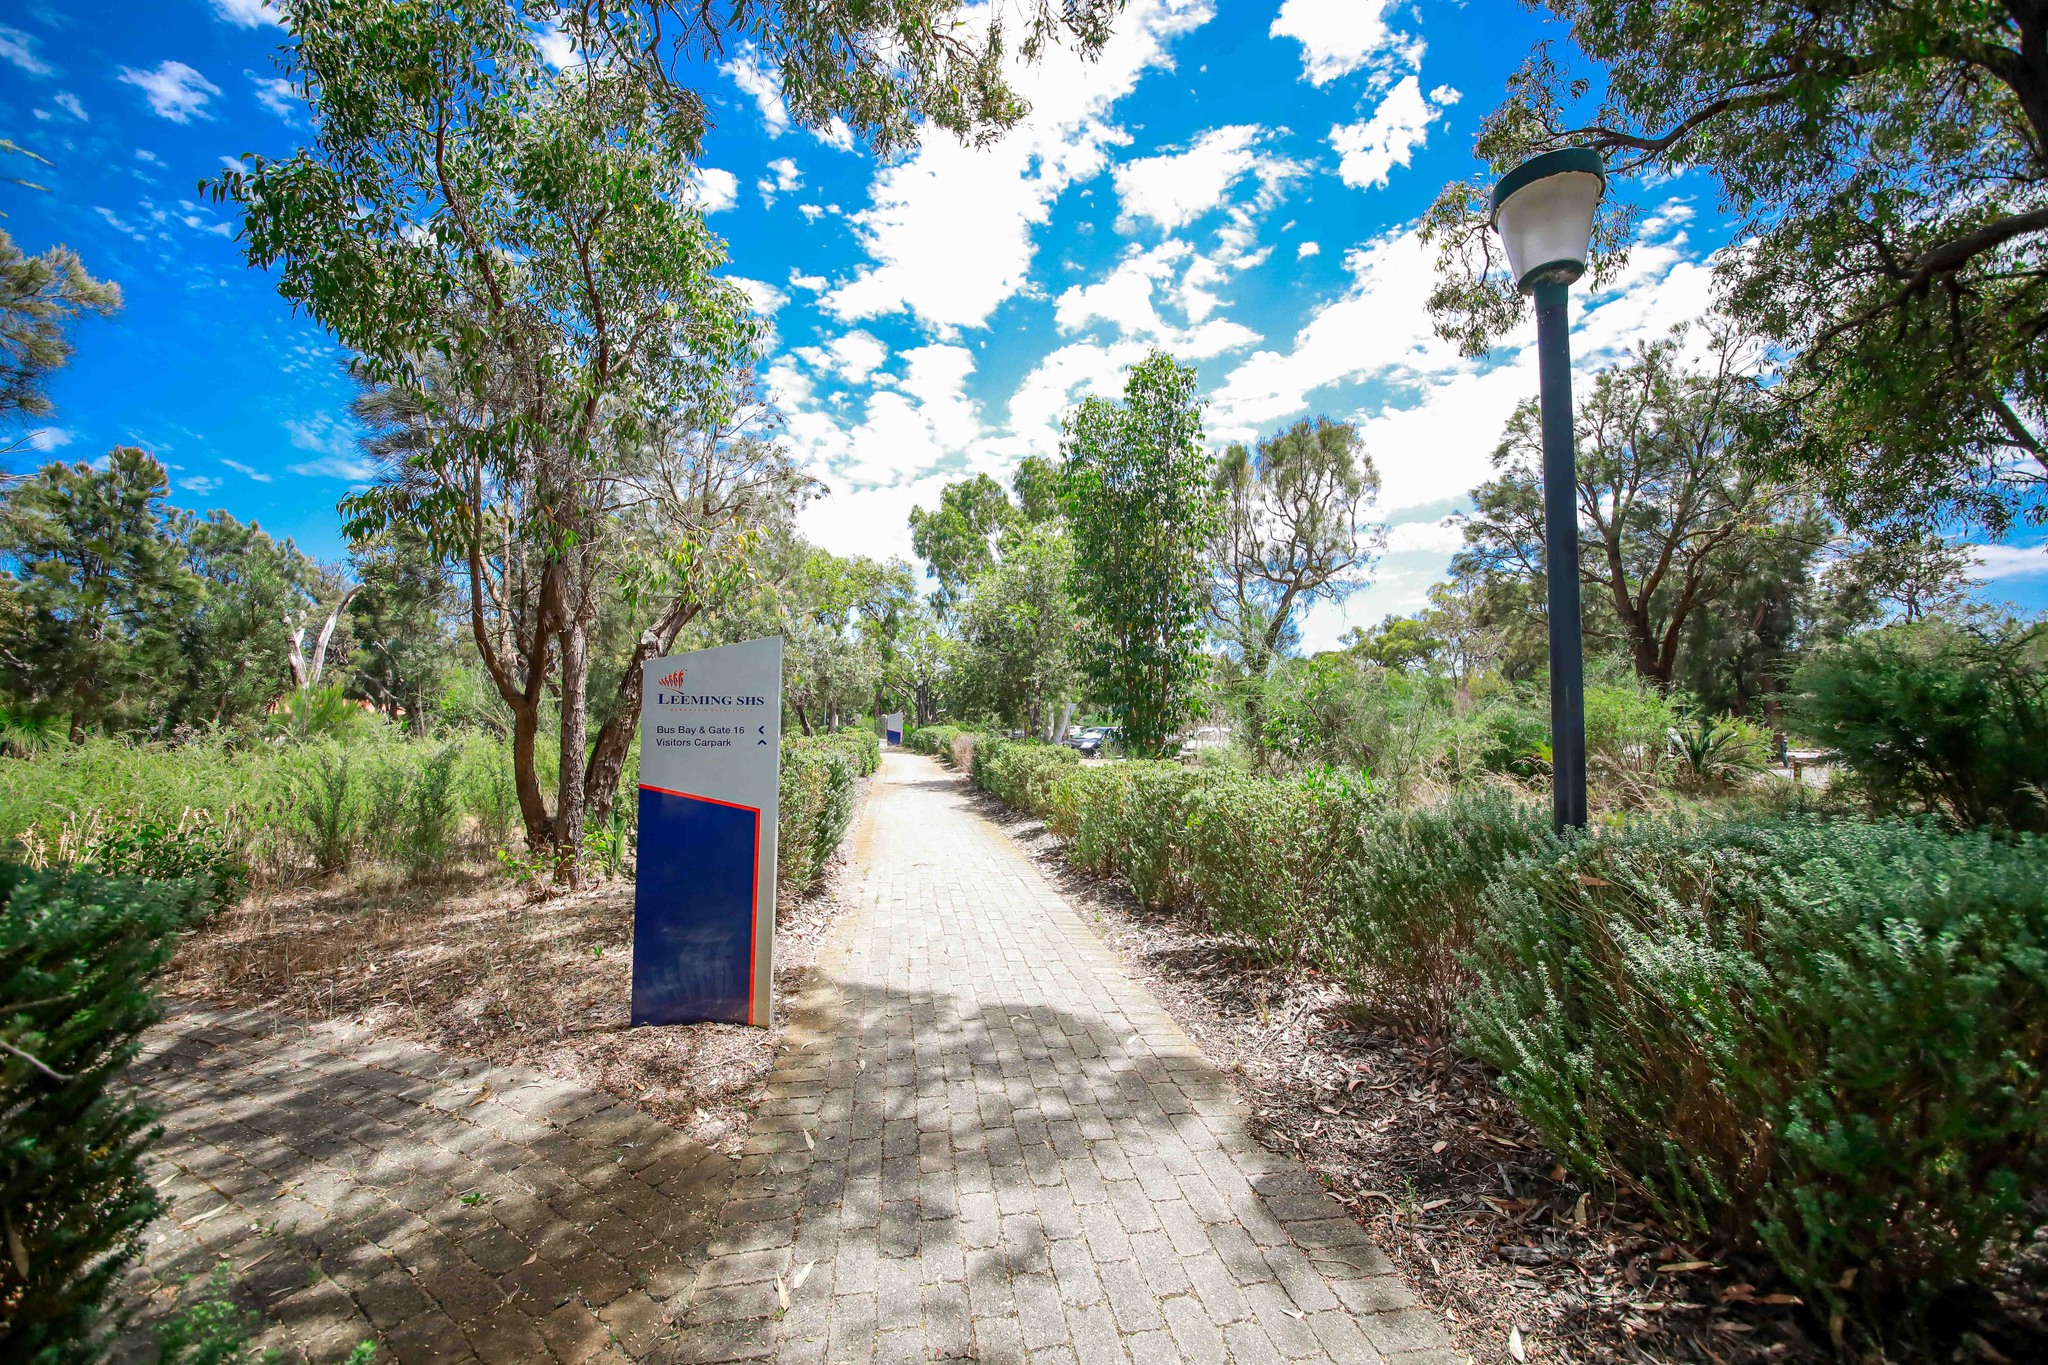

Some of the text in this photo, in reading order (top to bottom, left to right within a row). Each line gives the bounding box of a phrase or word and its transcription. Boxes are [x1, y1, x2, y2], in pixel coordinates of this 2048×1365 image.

[657, 693, 765, 706] LEEMING SHS
[656, 725, 745, 736] Bus Bay & Gate 16
[656, 737, 732, 749] Visitors Carpark
